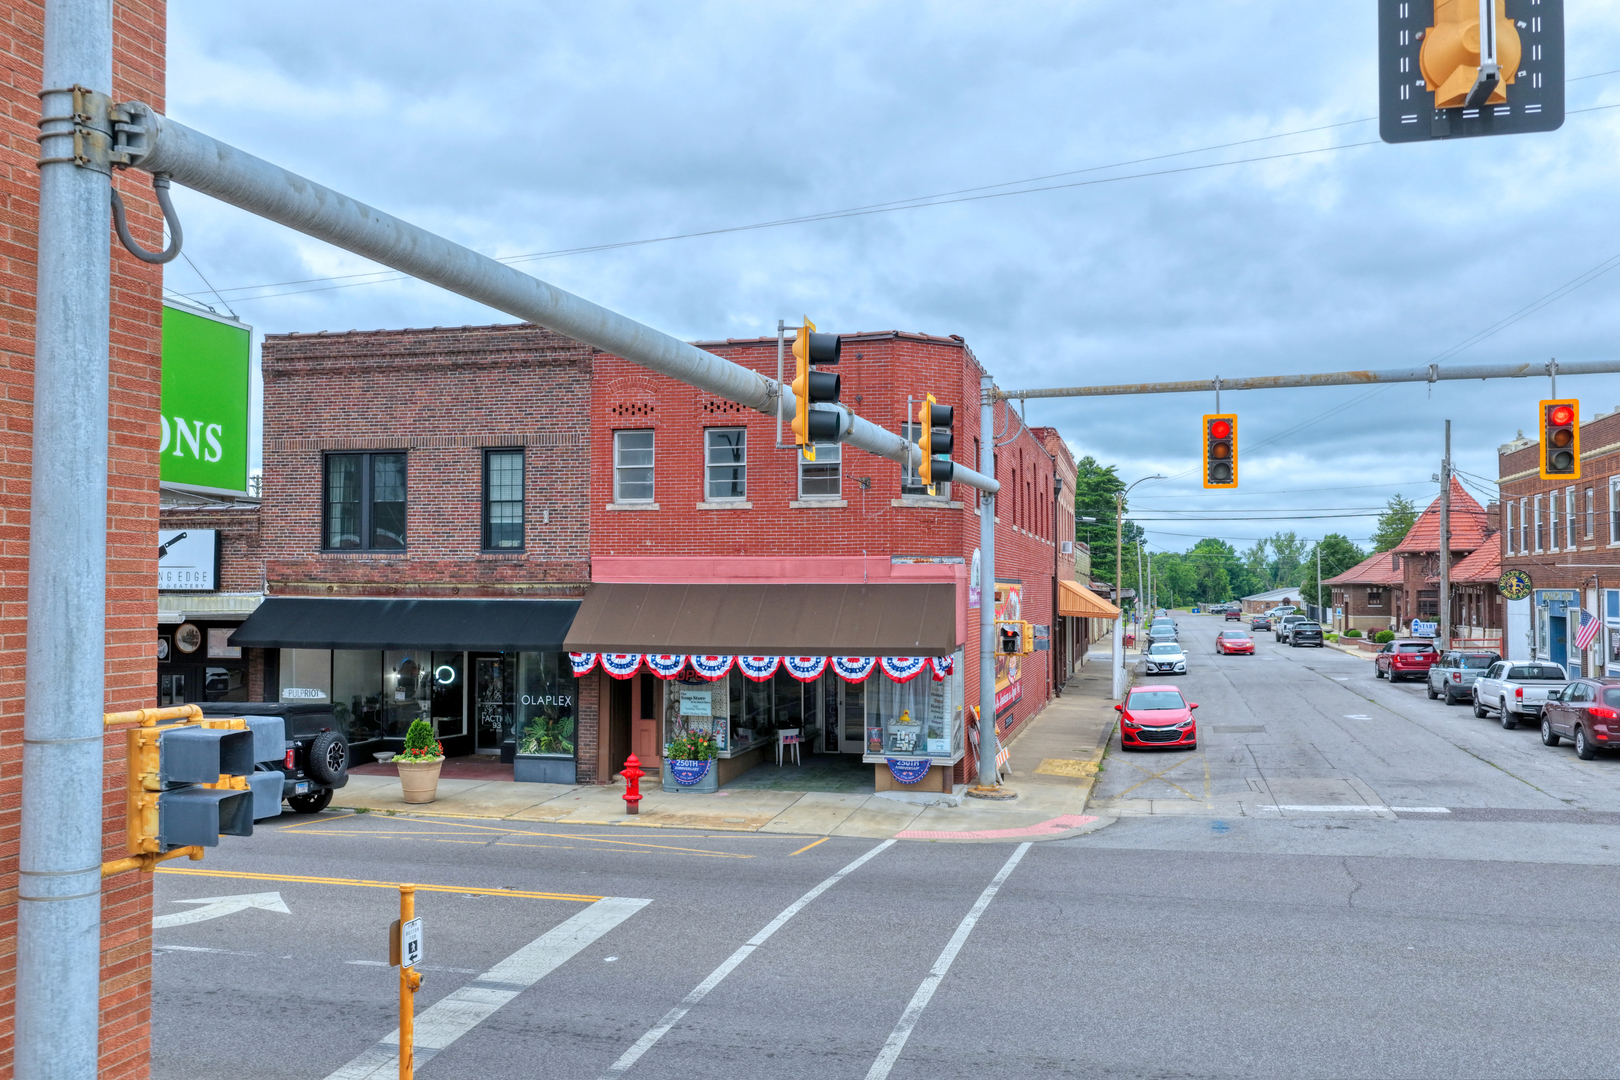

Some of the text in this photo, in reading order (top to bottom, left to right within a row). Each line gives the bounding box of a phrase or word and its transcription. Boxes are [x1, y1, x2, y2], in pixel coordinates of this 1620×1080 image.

[178, 571, 207, 582] EDGE
[521, 694, 571, 707] OLAPLEX
[481, 712, 512, 725] FACTIN
